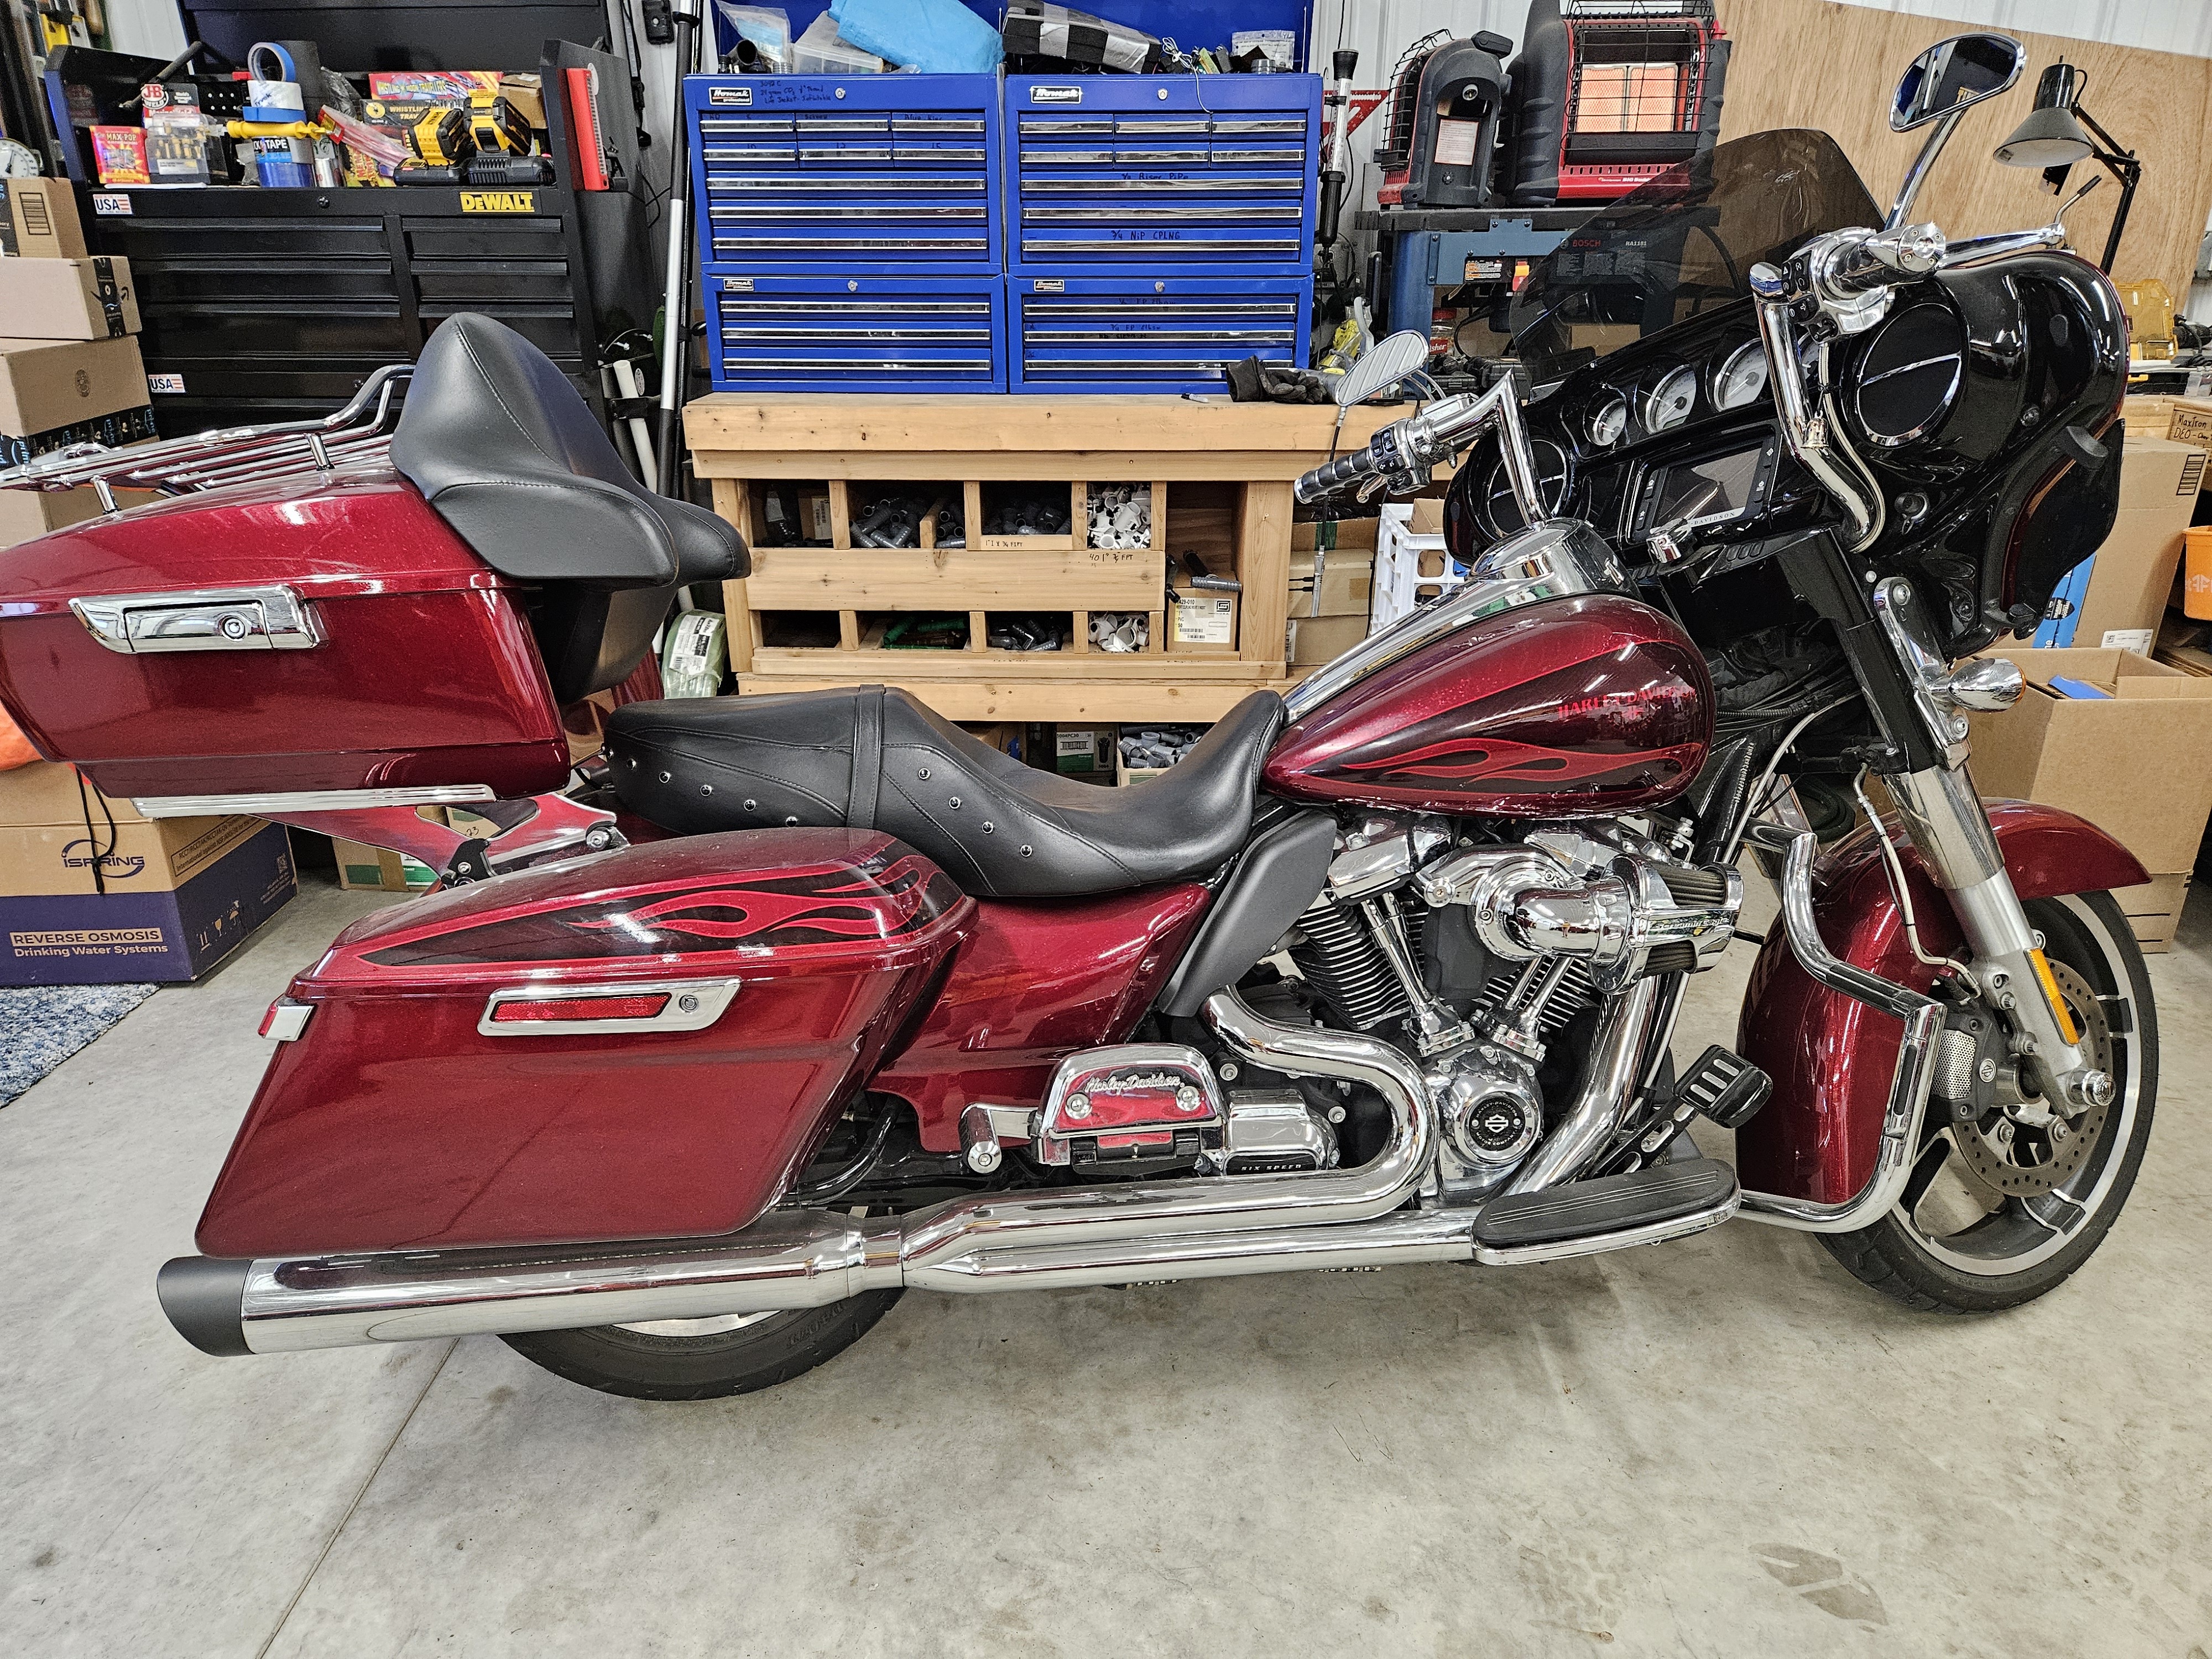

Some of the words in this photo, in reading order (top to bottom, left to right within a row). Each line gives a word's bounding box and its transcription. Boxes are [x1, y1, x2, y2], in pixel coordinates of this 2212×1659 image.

[267, 139, 288, 149] TAPE
[96, 199, 120, 210] USA
[1153, 231, 1180, 239] CPLNG
[150, 379, 173, 389] USA
[13, 933, 85, 944] REVERSE
[88, 931, 159, 941] OSMOSIS
[14, 946, 70, 957] Drinking
[72, 945, 111, 954] Water
[114, 945, 168, 956] Systems
[1476, 1131, 1491, 1145] MOTOR
[1493, 1131, 1516, 1146] COMPANY
